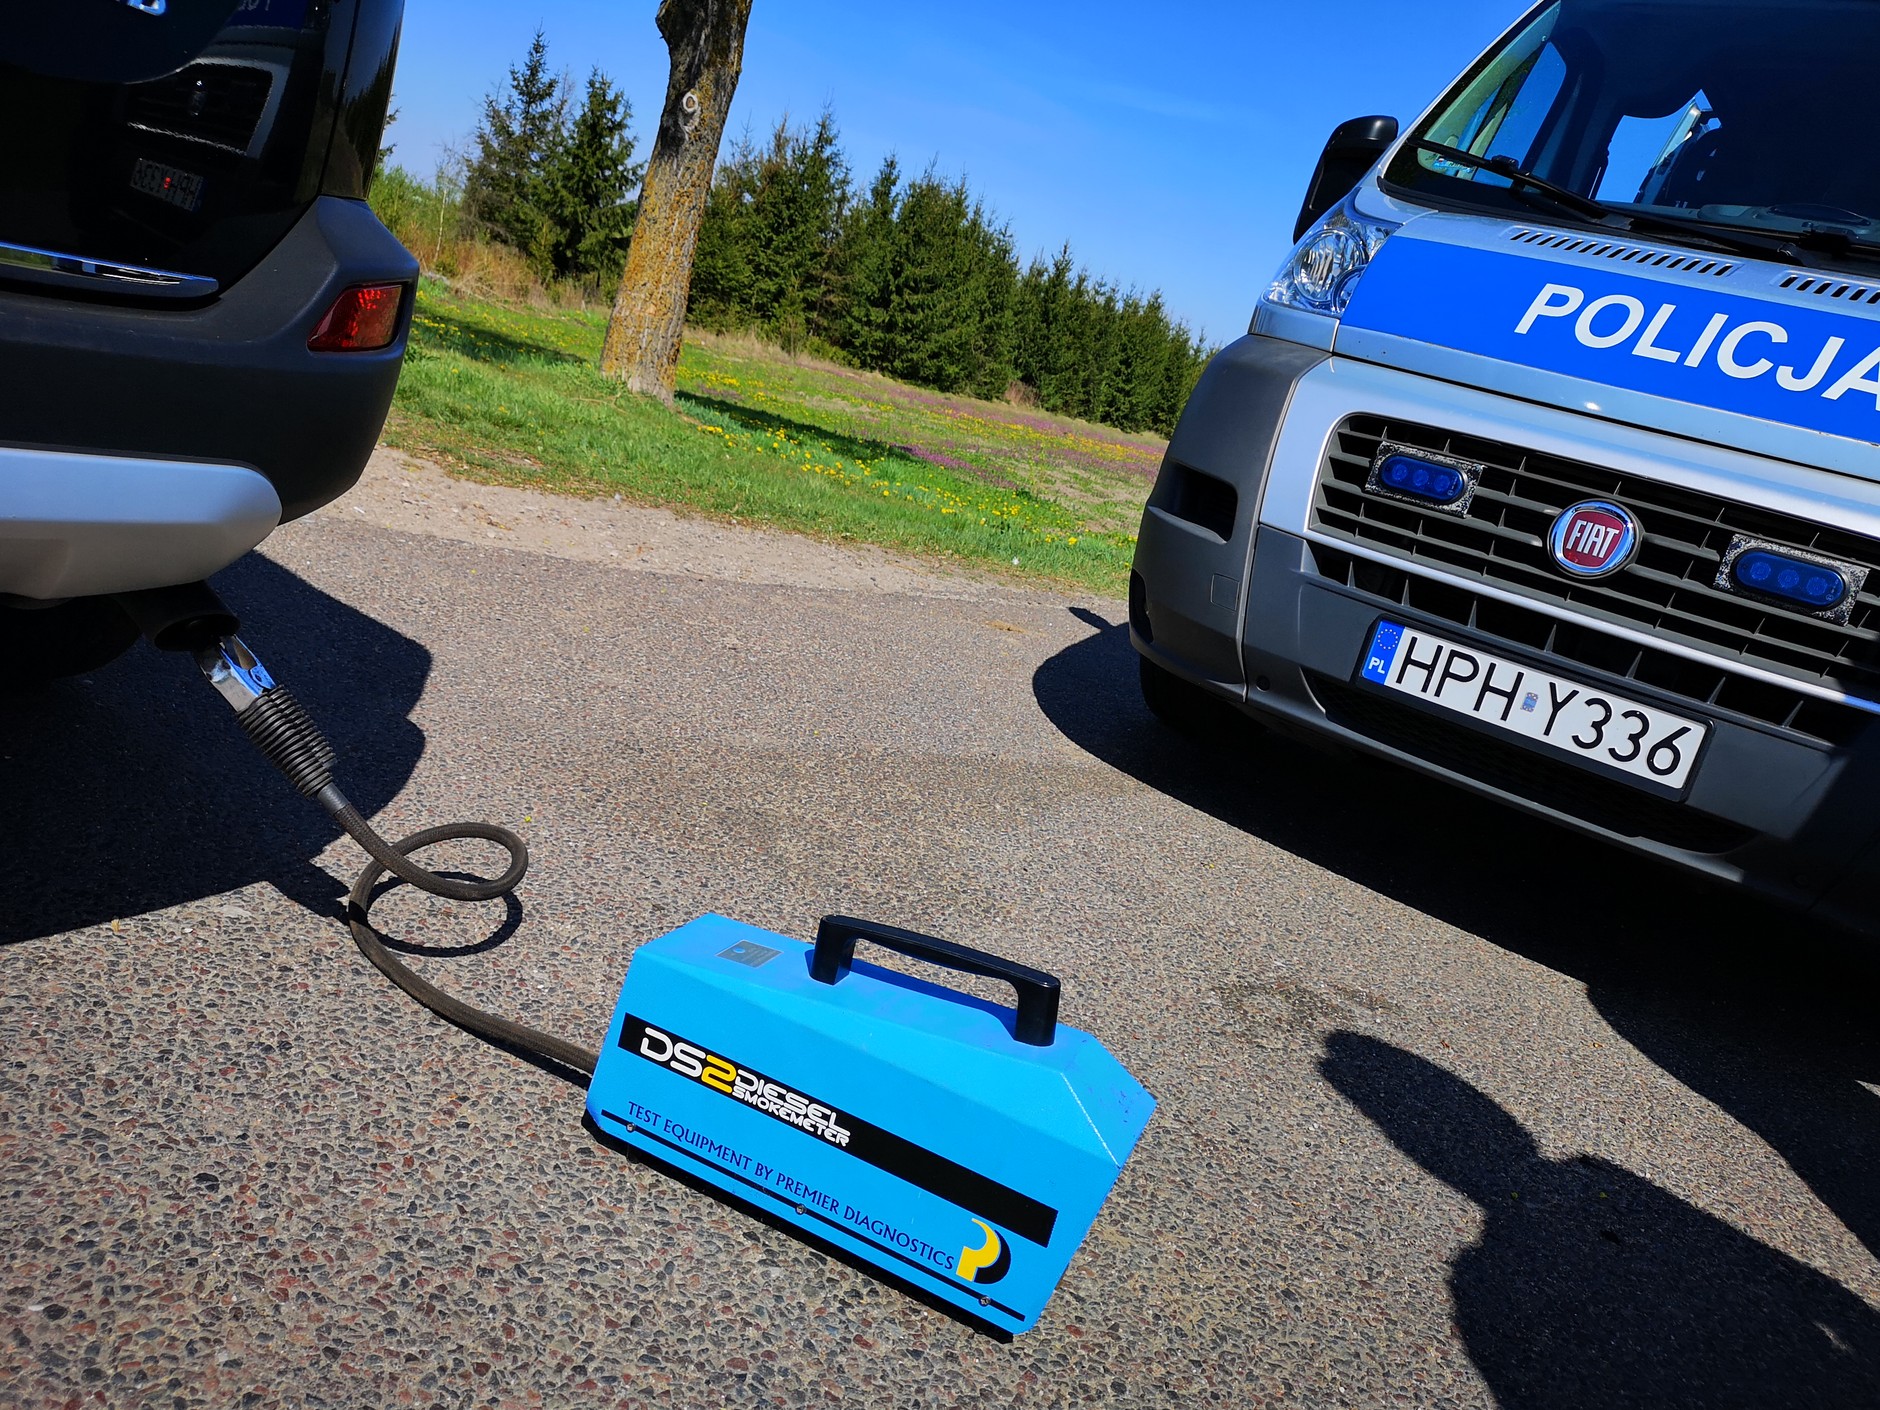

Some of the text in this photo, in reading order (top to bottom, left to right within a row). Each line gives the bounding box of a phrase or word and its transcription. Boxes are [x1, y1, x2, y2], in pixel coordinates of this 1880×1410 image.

[1514, 283, 1880, 412] POLICJA
[1565, 519, 1620, 559] FIAT
[1368, 656, 1386, 675] PL
[1395, 636, 1692, 776] HPH Y336
[640, 1027, 851, 1137] DS2 DIESEL
[731, 1085, 850, 1147] SMOKEMETER
[628, 1101, 955, 1270] TEST EQUIPMENT BY PREMIER DIAGNOSTICS
